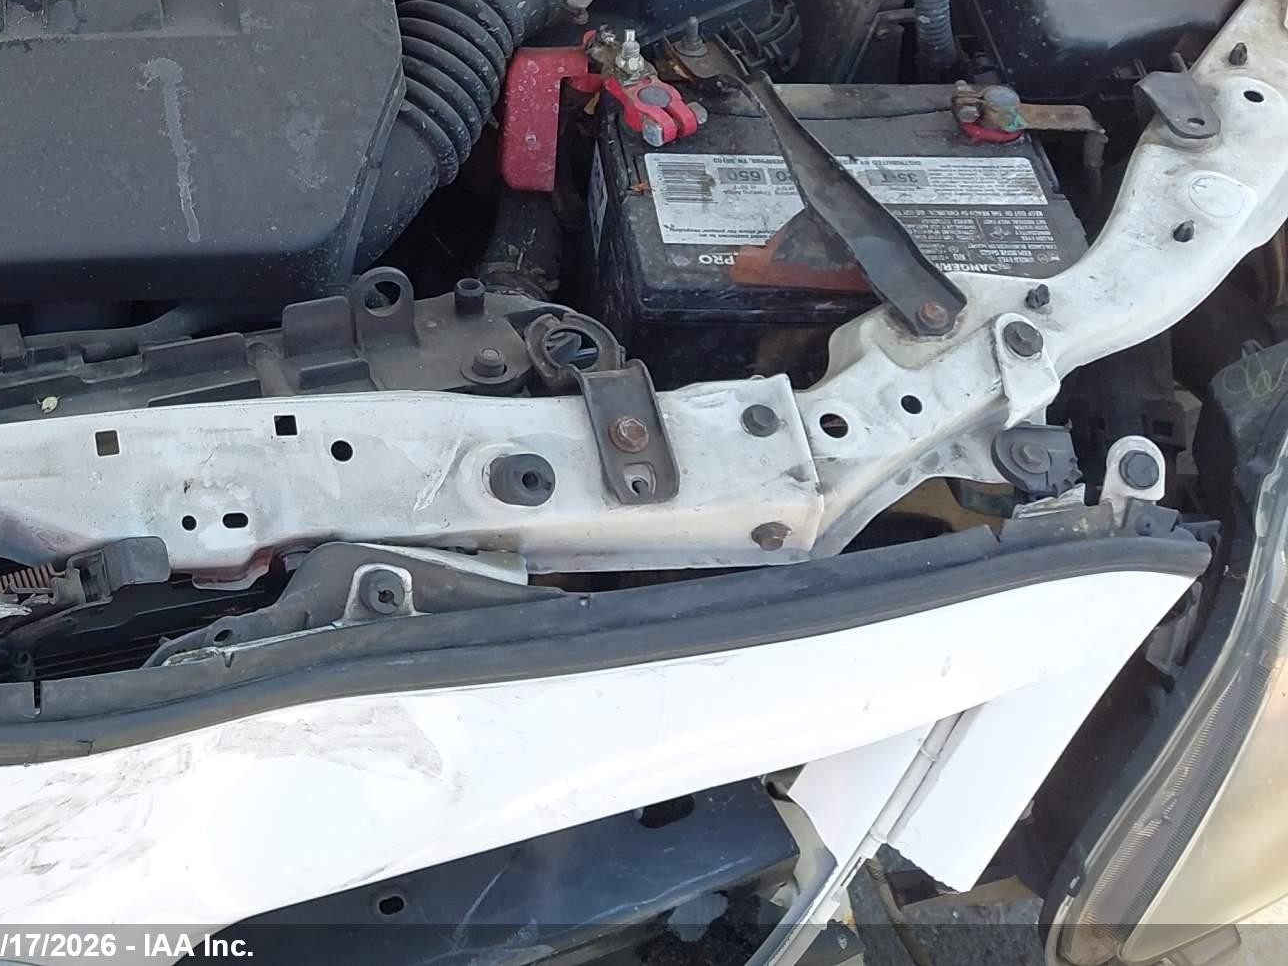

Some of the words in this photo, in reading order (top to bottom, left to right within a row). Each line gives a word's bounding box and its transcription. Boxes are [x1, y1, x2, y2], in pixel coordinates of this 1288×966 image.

[727, 170, 761, 182] 650
[880, 172, 919, 183] 35-T
[698, 254, 736, 265] PRO
